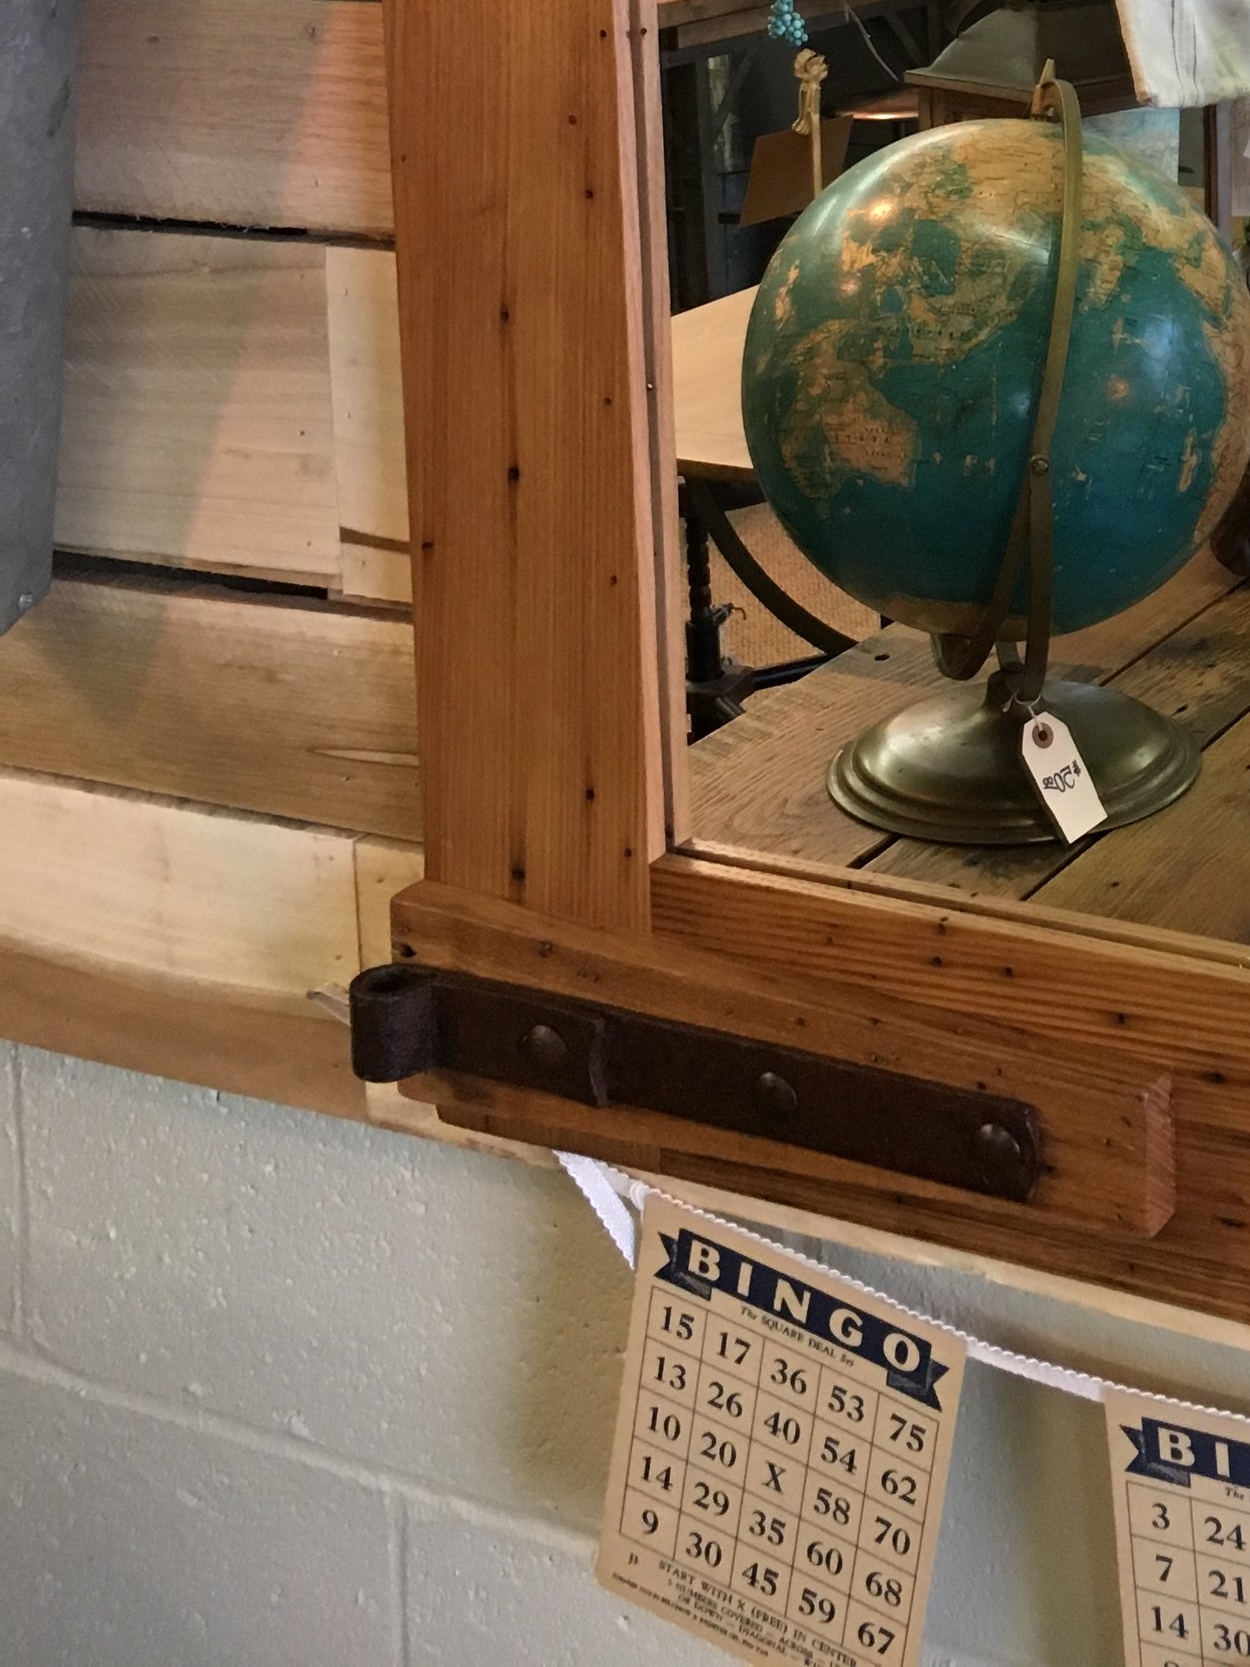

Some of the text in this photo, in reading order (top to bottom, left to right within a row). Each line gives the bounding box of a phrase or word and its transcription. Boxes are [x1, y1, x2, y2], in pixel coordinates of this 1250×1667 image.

[687, 1238, 920, 1372] BINGO
[807, 1337, 837, 1358] DEAL
[654, 1356, 918, 1506] 13 26 40 54 62
[661, 1306, 927, 1453] 15 17 36 53 75
[640, 1456, 903, 1607] 14 29 35 60 68
[647, 1406, 911, 1556] 10 20 X 58 70
[1151, 1502, 1171, 1530] 3
[1203, 1516, 1247, 1551] 24
[1225, 1486, 1245, 1501] The
[641, 1509, 896, 1655] 9 30 45 59 67
[658, 1559, 697, 1584] START
[700, 1580, 734, 1604] WITH
[792, 1625, 807, 1641] IN
[810, 1631, 858, 1667] CENTER
[1150, 1605, 1189, 1640] 14
[1155, 1553, 1174, 1582] 7
[1208, 1569, 1246, 1604] 21
